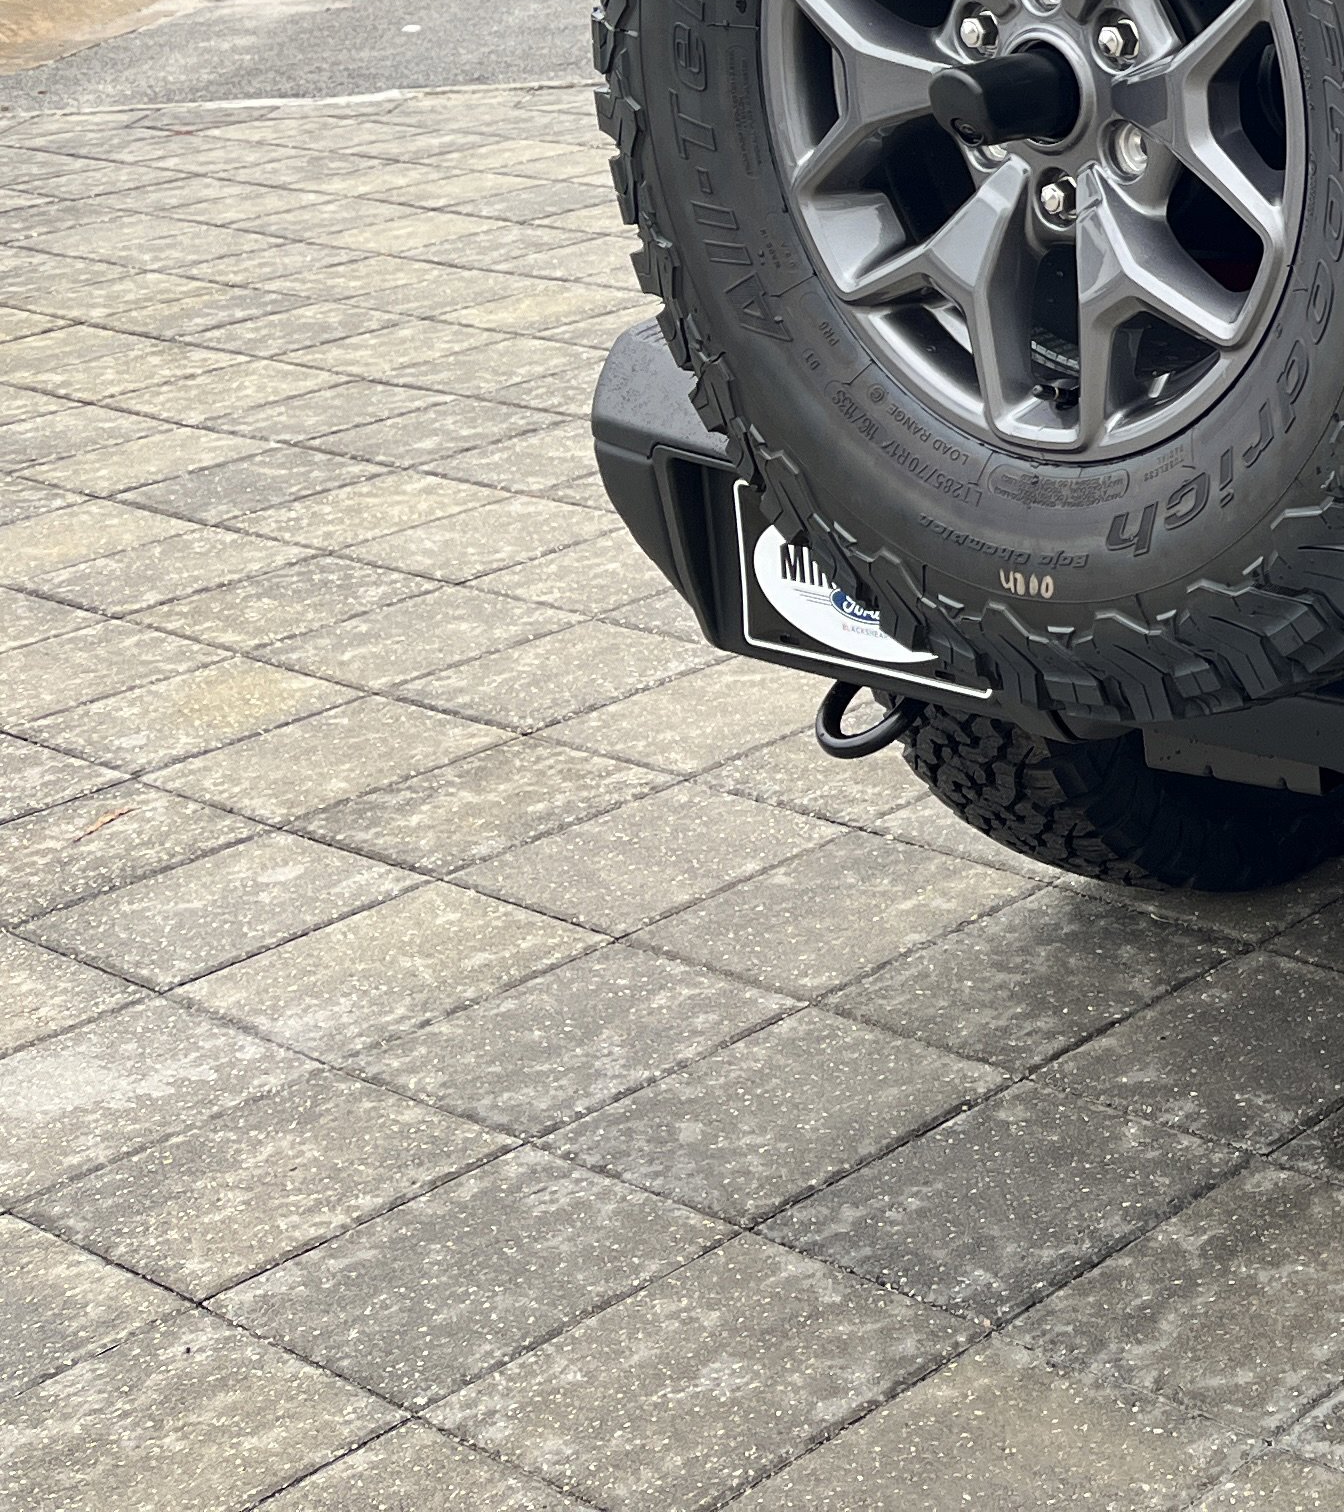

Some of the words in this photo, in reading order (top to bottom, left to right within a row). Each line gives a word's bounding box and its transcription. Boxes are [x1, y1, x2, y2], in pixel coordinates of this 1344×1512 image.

[831, 389, 880, 441] 116/113S
[887, 402, 933, 442] RANGE
[880, 436, 983, 508] LT285/70R17
[931, 438, 970, 466] LOAD
[780, 543, 836, 590] MI
[841, 623, 889, 640] BLACKSHEA
